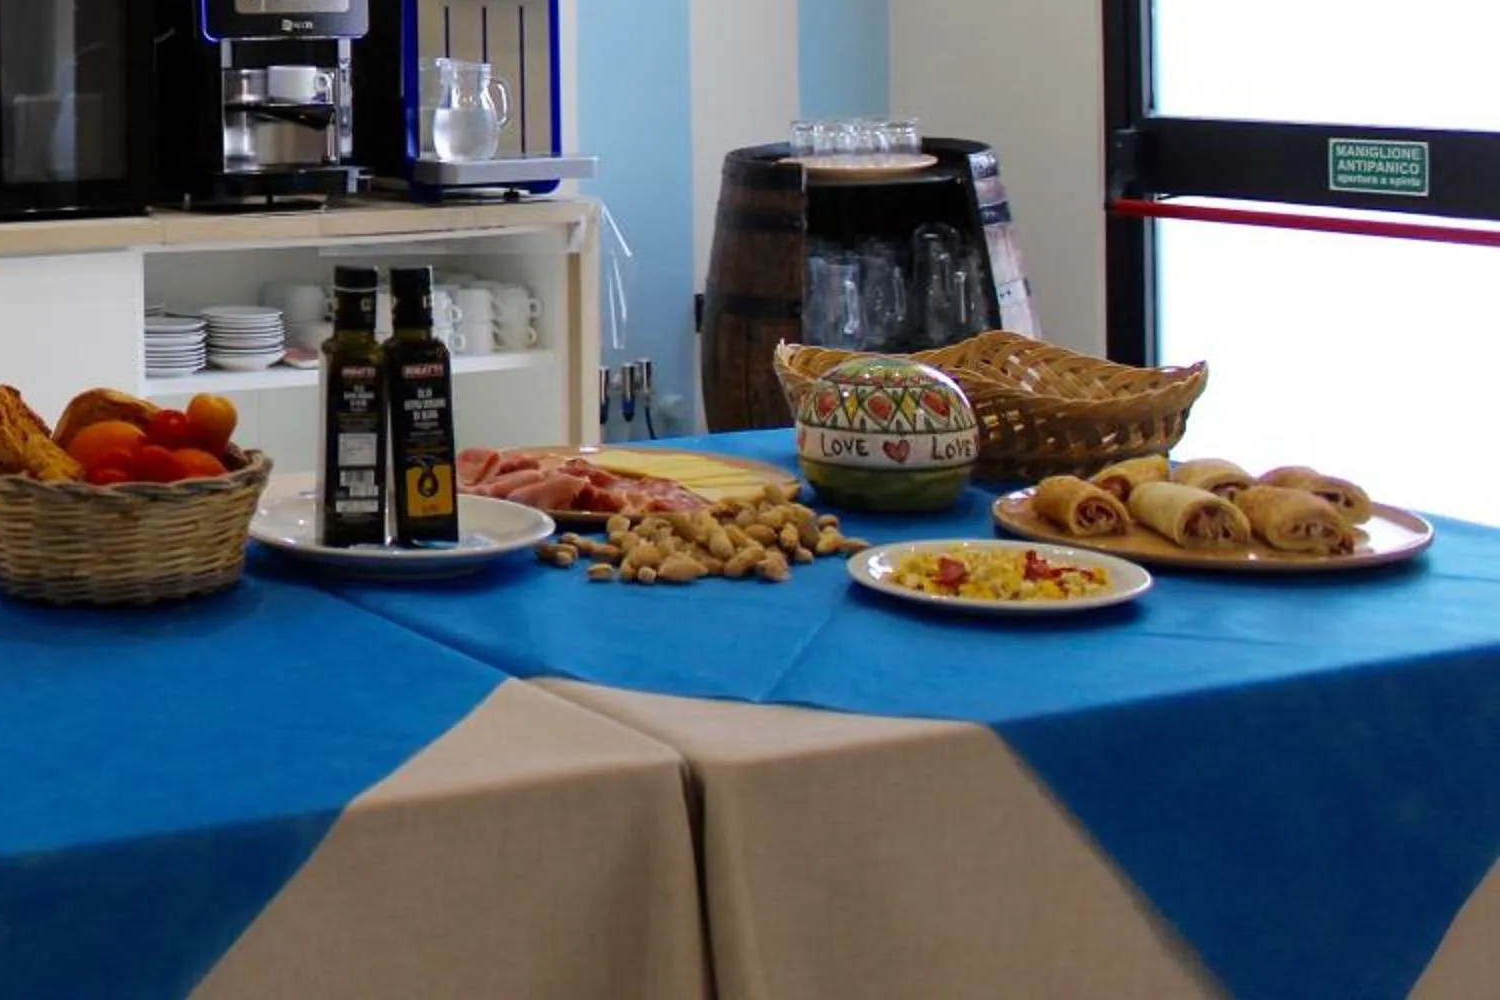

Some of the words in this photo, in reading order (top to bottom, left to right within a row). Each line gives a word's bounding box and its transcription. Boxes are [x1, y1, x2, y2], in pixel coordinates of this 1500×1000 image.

[1335, 144, 1422, 160] MANIGLIONE
[1337, 159, 1420, 175] ANTIPANICO
[821, 433, 868, 457] LOVE
[931, 435, 973, 459] LOVE
